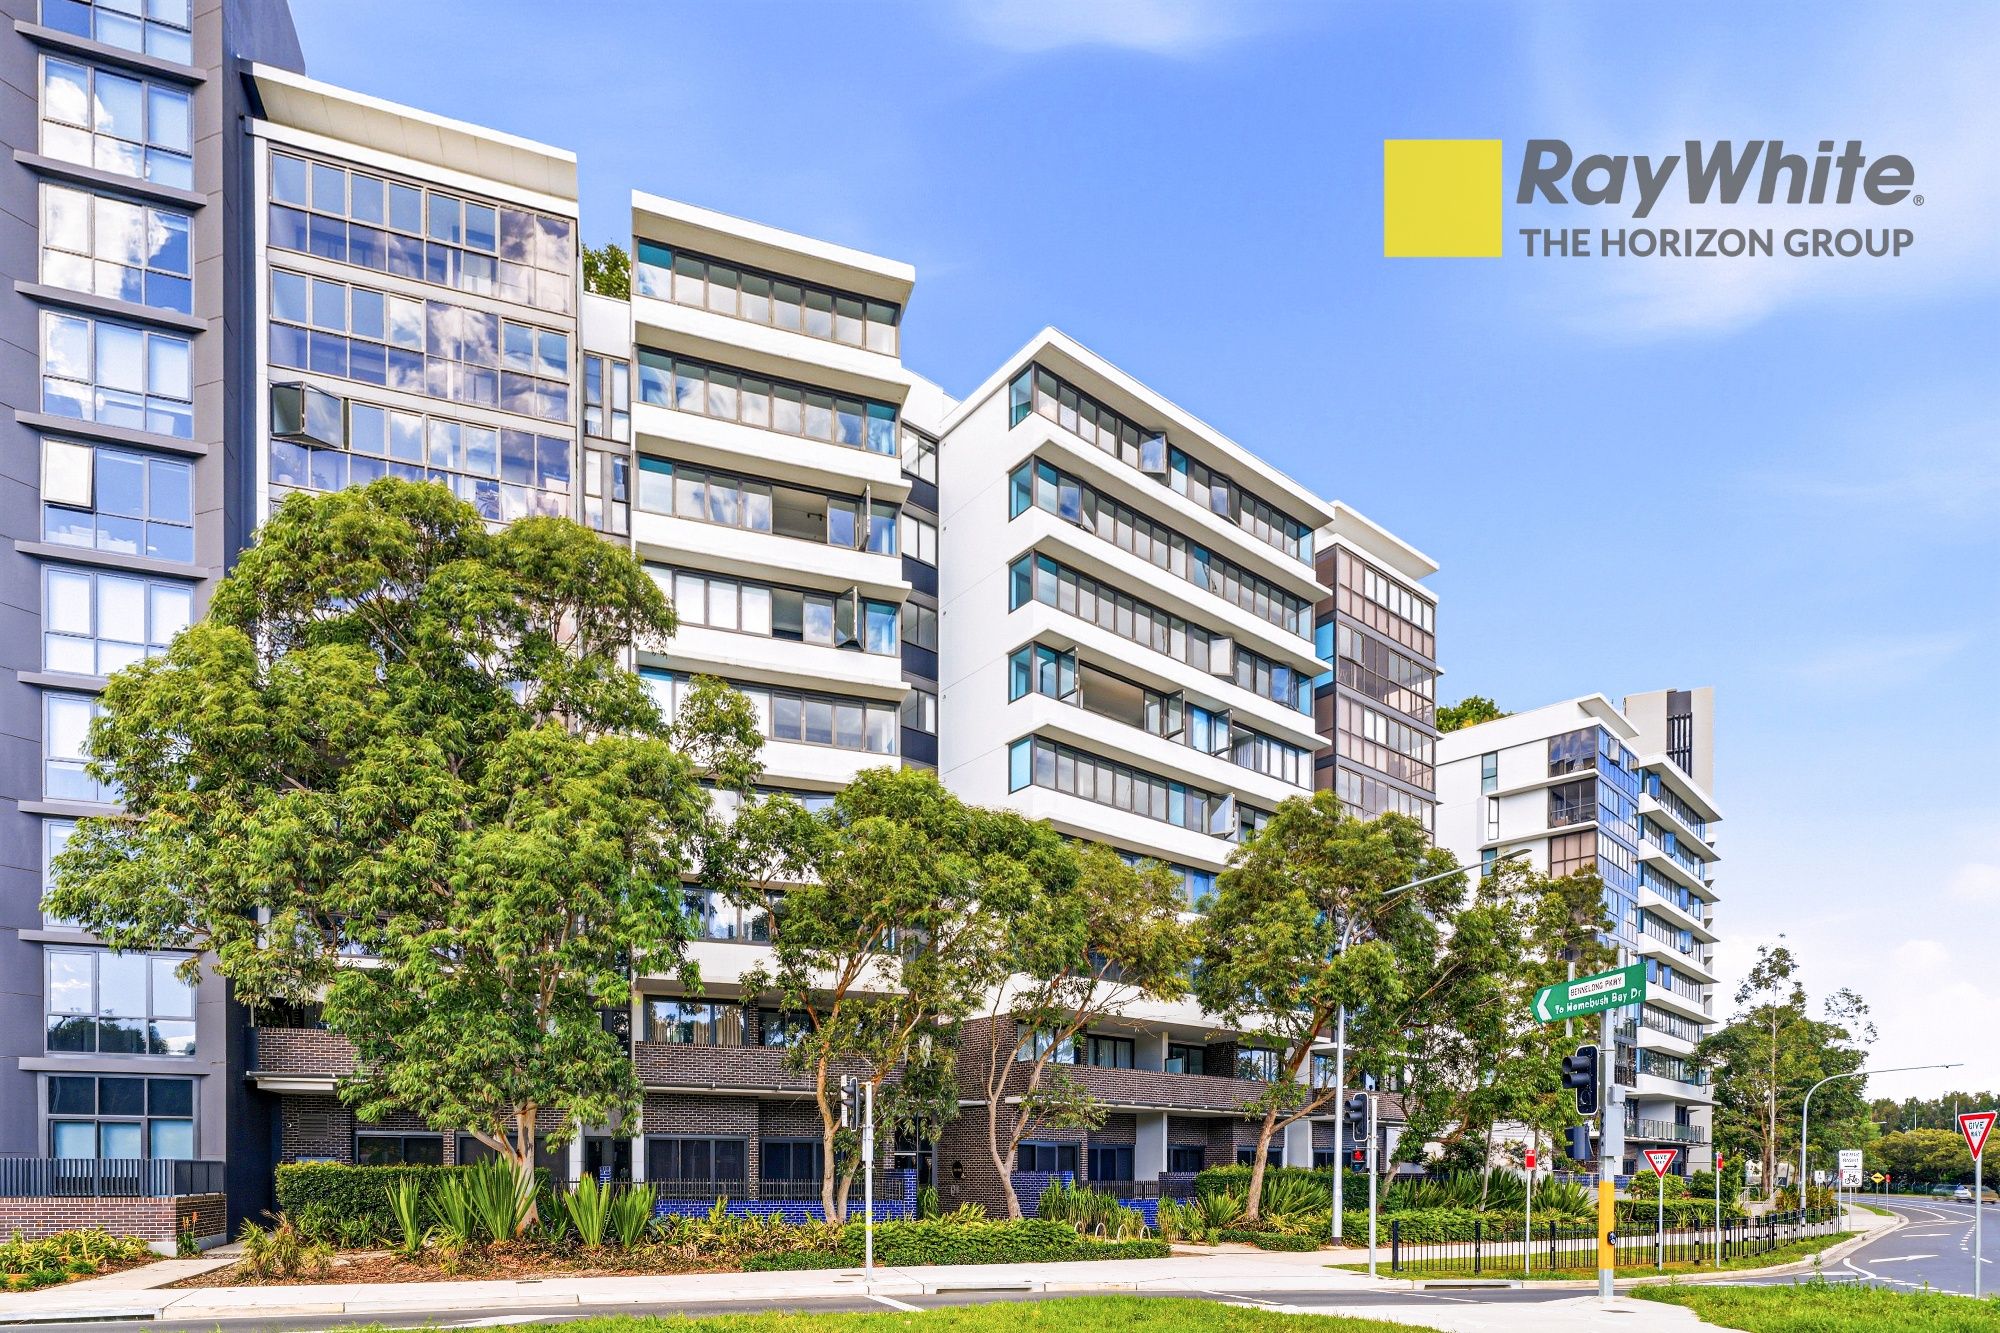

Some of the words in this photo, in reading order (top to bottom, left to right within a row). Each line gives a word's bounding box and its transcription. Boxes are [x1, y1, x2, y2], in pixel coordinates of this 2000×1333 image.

[1570, 982, 1603, 997] BENNELONG
[1605, 977, 1623, 987] PKWY
[1555, 1004, 1564, 1015] To
[1566, 995, 1608, 1012] Homebush
[1612, 992, 1627, 1003] Bay
[1630, 988, 1642, 999] Dr
[1968, 1121, 1985, 1130] GIVE
